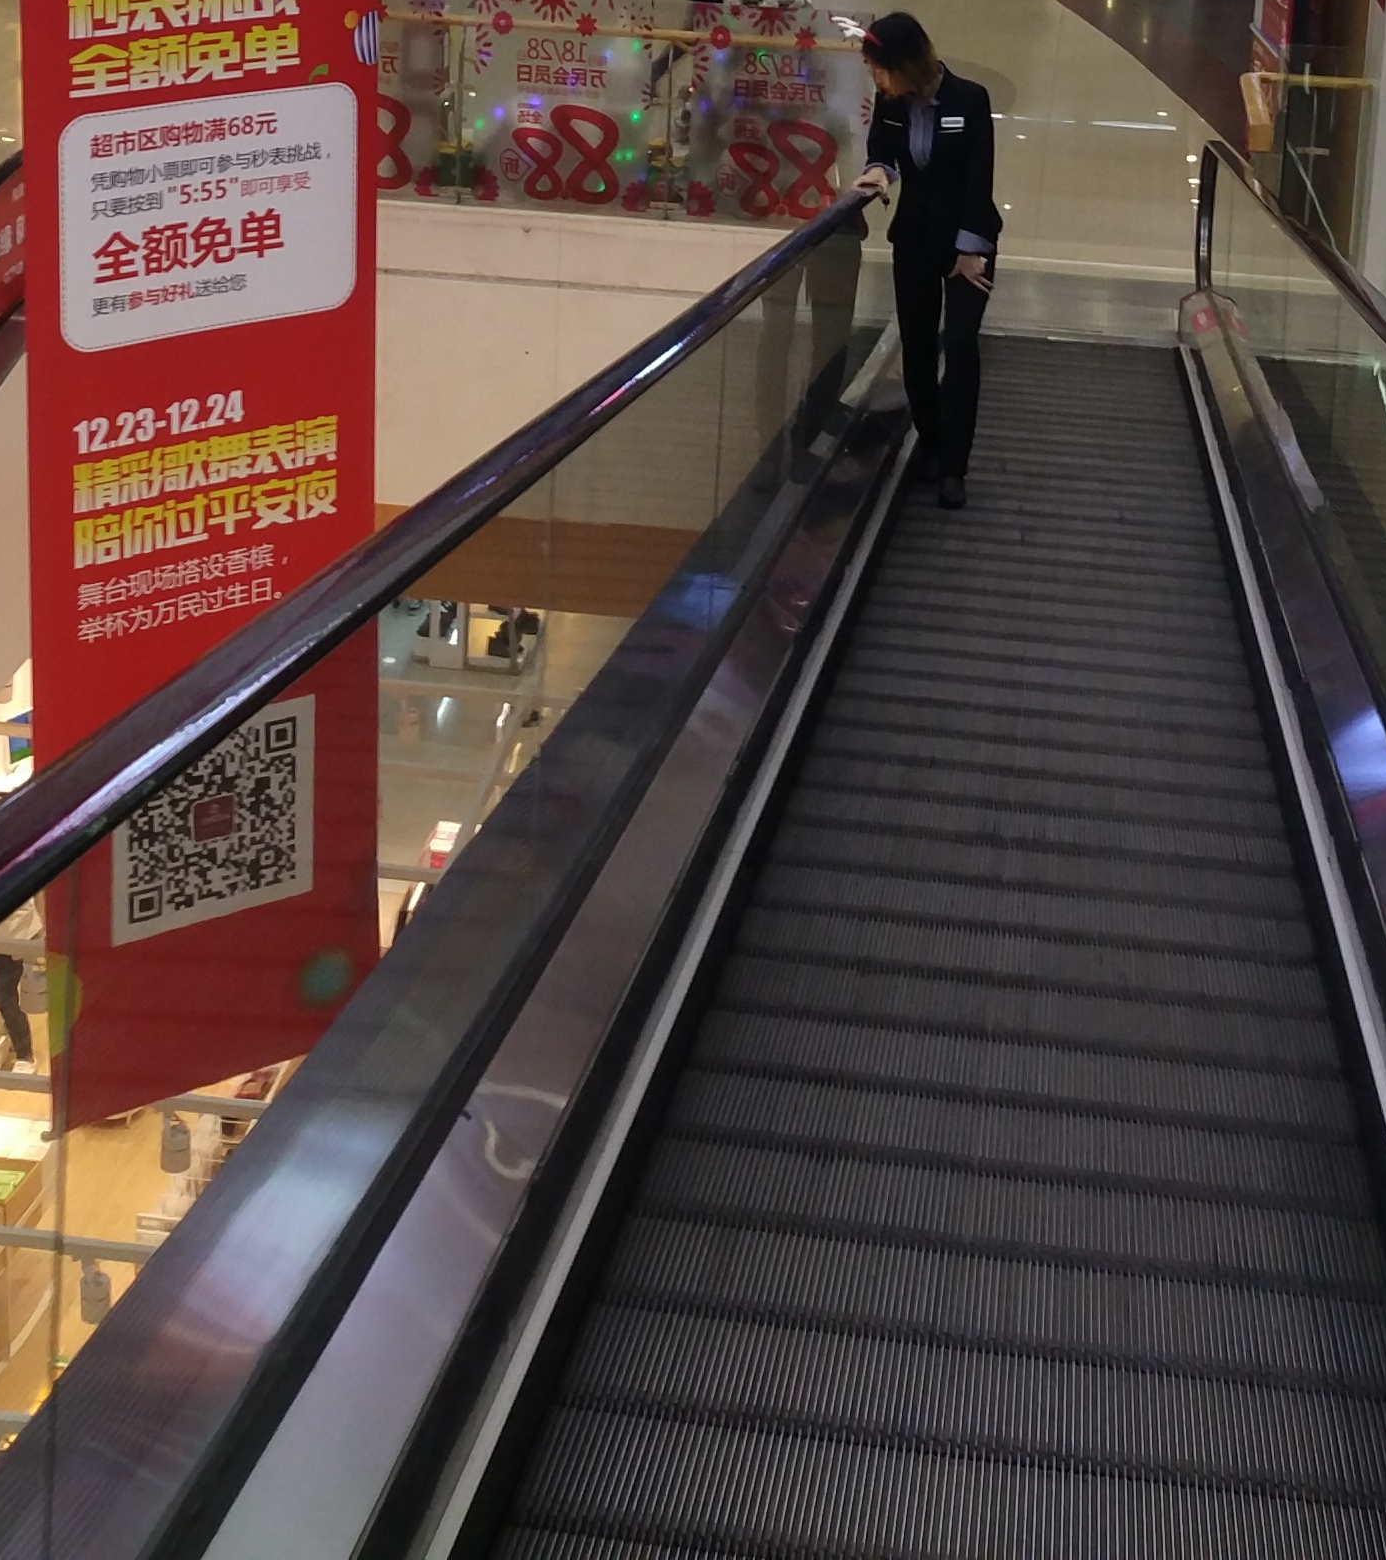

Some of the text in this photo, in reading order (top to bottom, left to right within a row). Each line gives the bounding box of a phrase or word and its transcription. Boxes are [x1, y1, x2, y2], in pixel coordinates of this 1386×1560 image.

[69, 23, 301, 98] 全额免单
[90, 111, 278, 159] 超市区购物满68元
[92, 208, 285, 284] 全额免单
[73, 390, 245, 455] 12.23-12.24
[73, 415, 339, 514] 精彩歌舞表演
[73, 469, 337, 570] 陪你过平安夜
